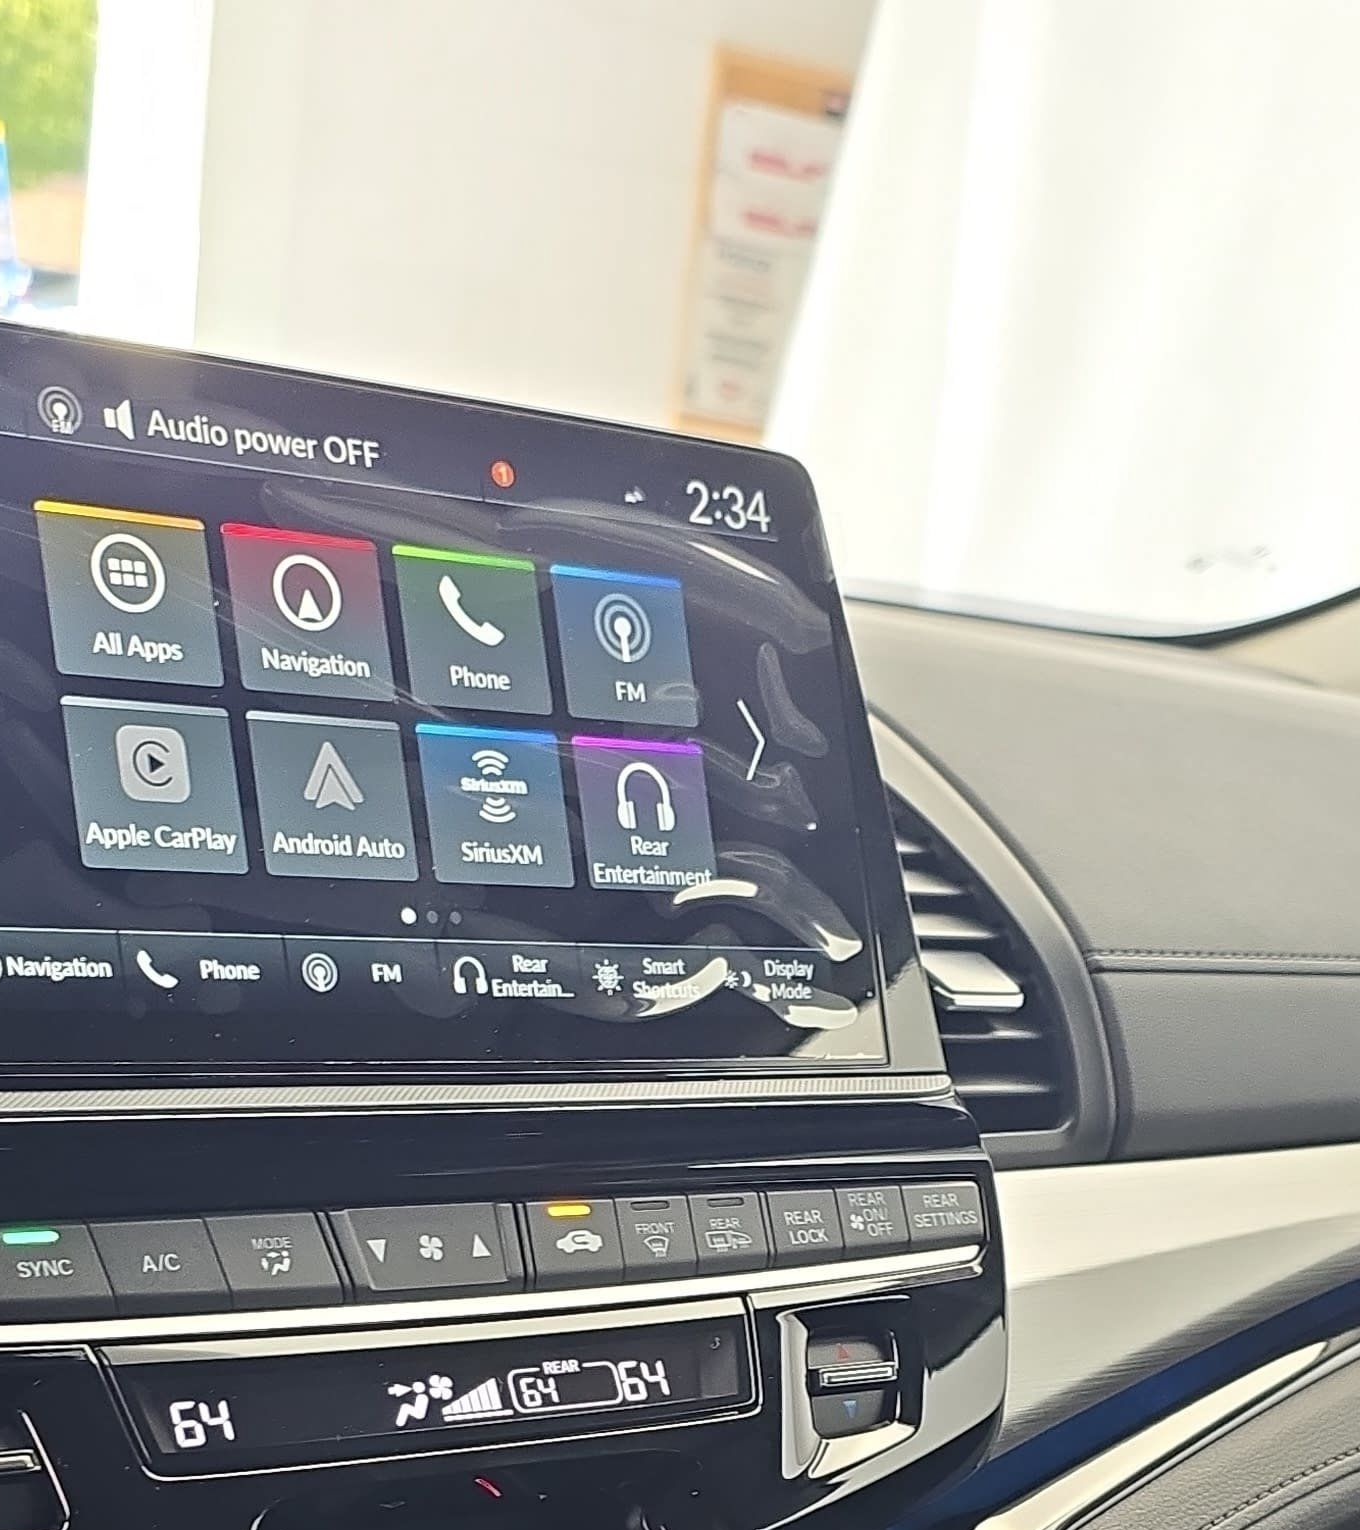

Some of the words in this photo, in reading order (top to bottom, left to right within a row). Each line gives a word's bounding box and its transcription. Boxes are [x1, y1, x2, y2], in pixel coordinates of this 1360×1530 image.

[146, 408, 229, 447] Audio
[234, 420, 317, 460] power
[323, 434, 381, 468] OFF
[685, 478, 772, 534] 2:34
[92, 631, 123, 656] All
[127, 634, 184, 662] Apps
[261, 647, 371, 679] Navigation
[449, 665, 512, 692] Phone
[615, 680, 647, 703] FM
[85, 822, 151, 850] Apple
[154, 826, 237, 855] CarPlay
[272, 832, 354, 858] Android
[357, 835, 406, 860] Auto
[630, 835, 670, 857] Rear
[461, 840, 544, 865] SiriusXM
[593, 862, 713, 887] Entertainment
[5, 955, 114, 983] Navigation
[199, 959, 262, 982] Phone
[370, 962, 403, 984] FM
[512, 954, 549, 974] Rear
[642, 957, 687, 975] Smart
[764, 959, 814, 981] Display
[770, 981, 813, 1001] Mode
[847, 1190, 887, 1208] REAR
[923, 1192, 960, 1209] REAR
[709, 1216, 741, 1231] REAR
[783, 1209, 824, 1227] REAR
[862, 1206, 892, 1224] ON/
[913, 1209, 979, 1230] SETTINGS
[634, 1219, 676, 1236] FRONT
[789, 1226, 830, 1246] LOCK
[866, 1219, 896, 1238] OFF
[250, 1234, 294, 1251] MODE
[15, 1258, 75, 1280] SYNC
[141, 1252, 182, 1273] A/C
[542, 1357, 581, 1375] REAR
[619, 1359, 673, 1402] 64
[520, 1376, 560, 1409] 64
[170, 1399, 236, 1450] 64
